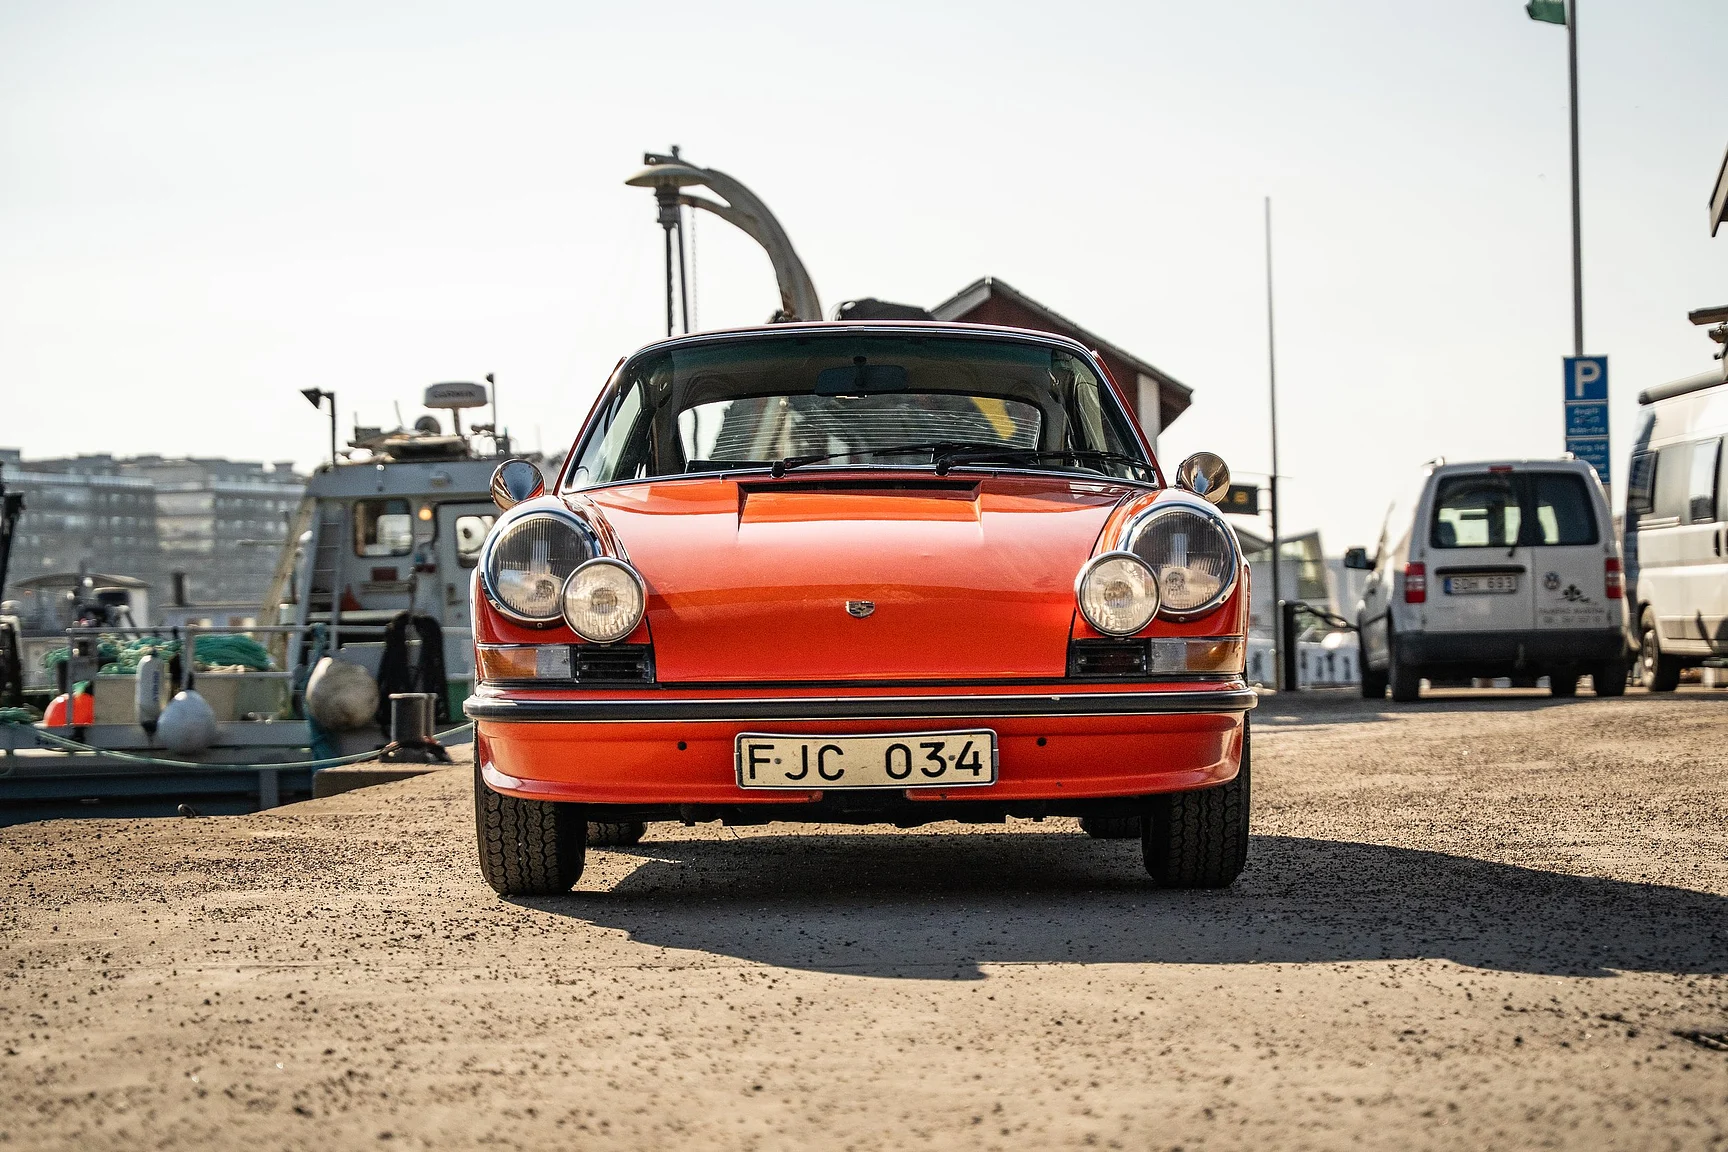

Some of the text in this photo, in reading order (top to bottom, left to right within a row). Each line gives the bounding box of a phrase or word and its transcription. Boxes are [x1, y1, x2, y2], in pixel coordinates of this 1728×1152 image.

[1574, 360, 1601, 397] P
[748, 740, 983, 781] FJC 034
